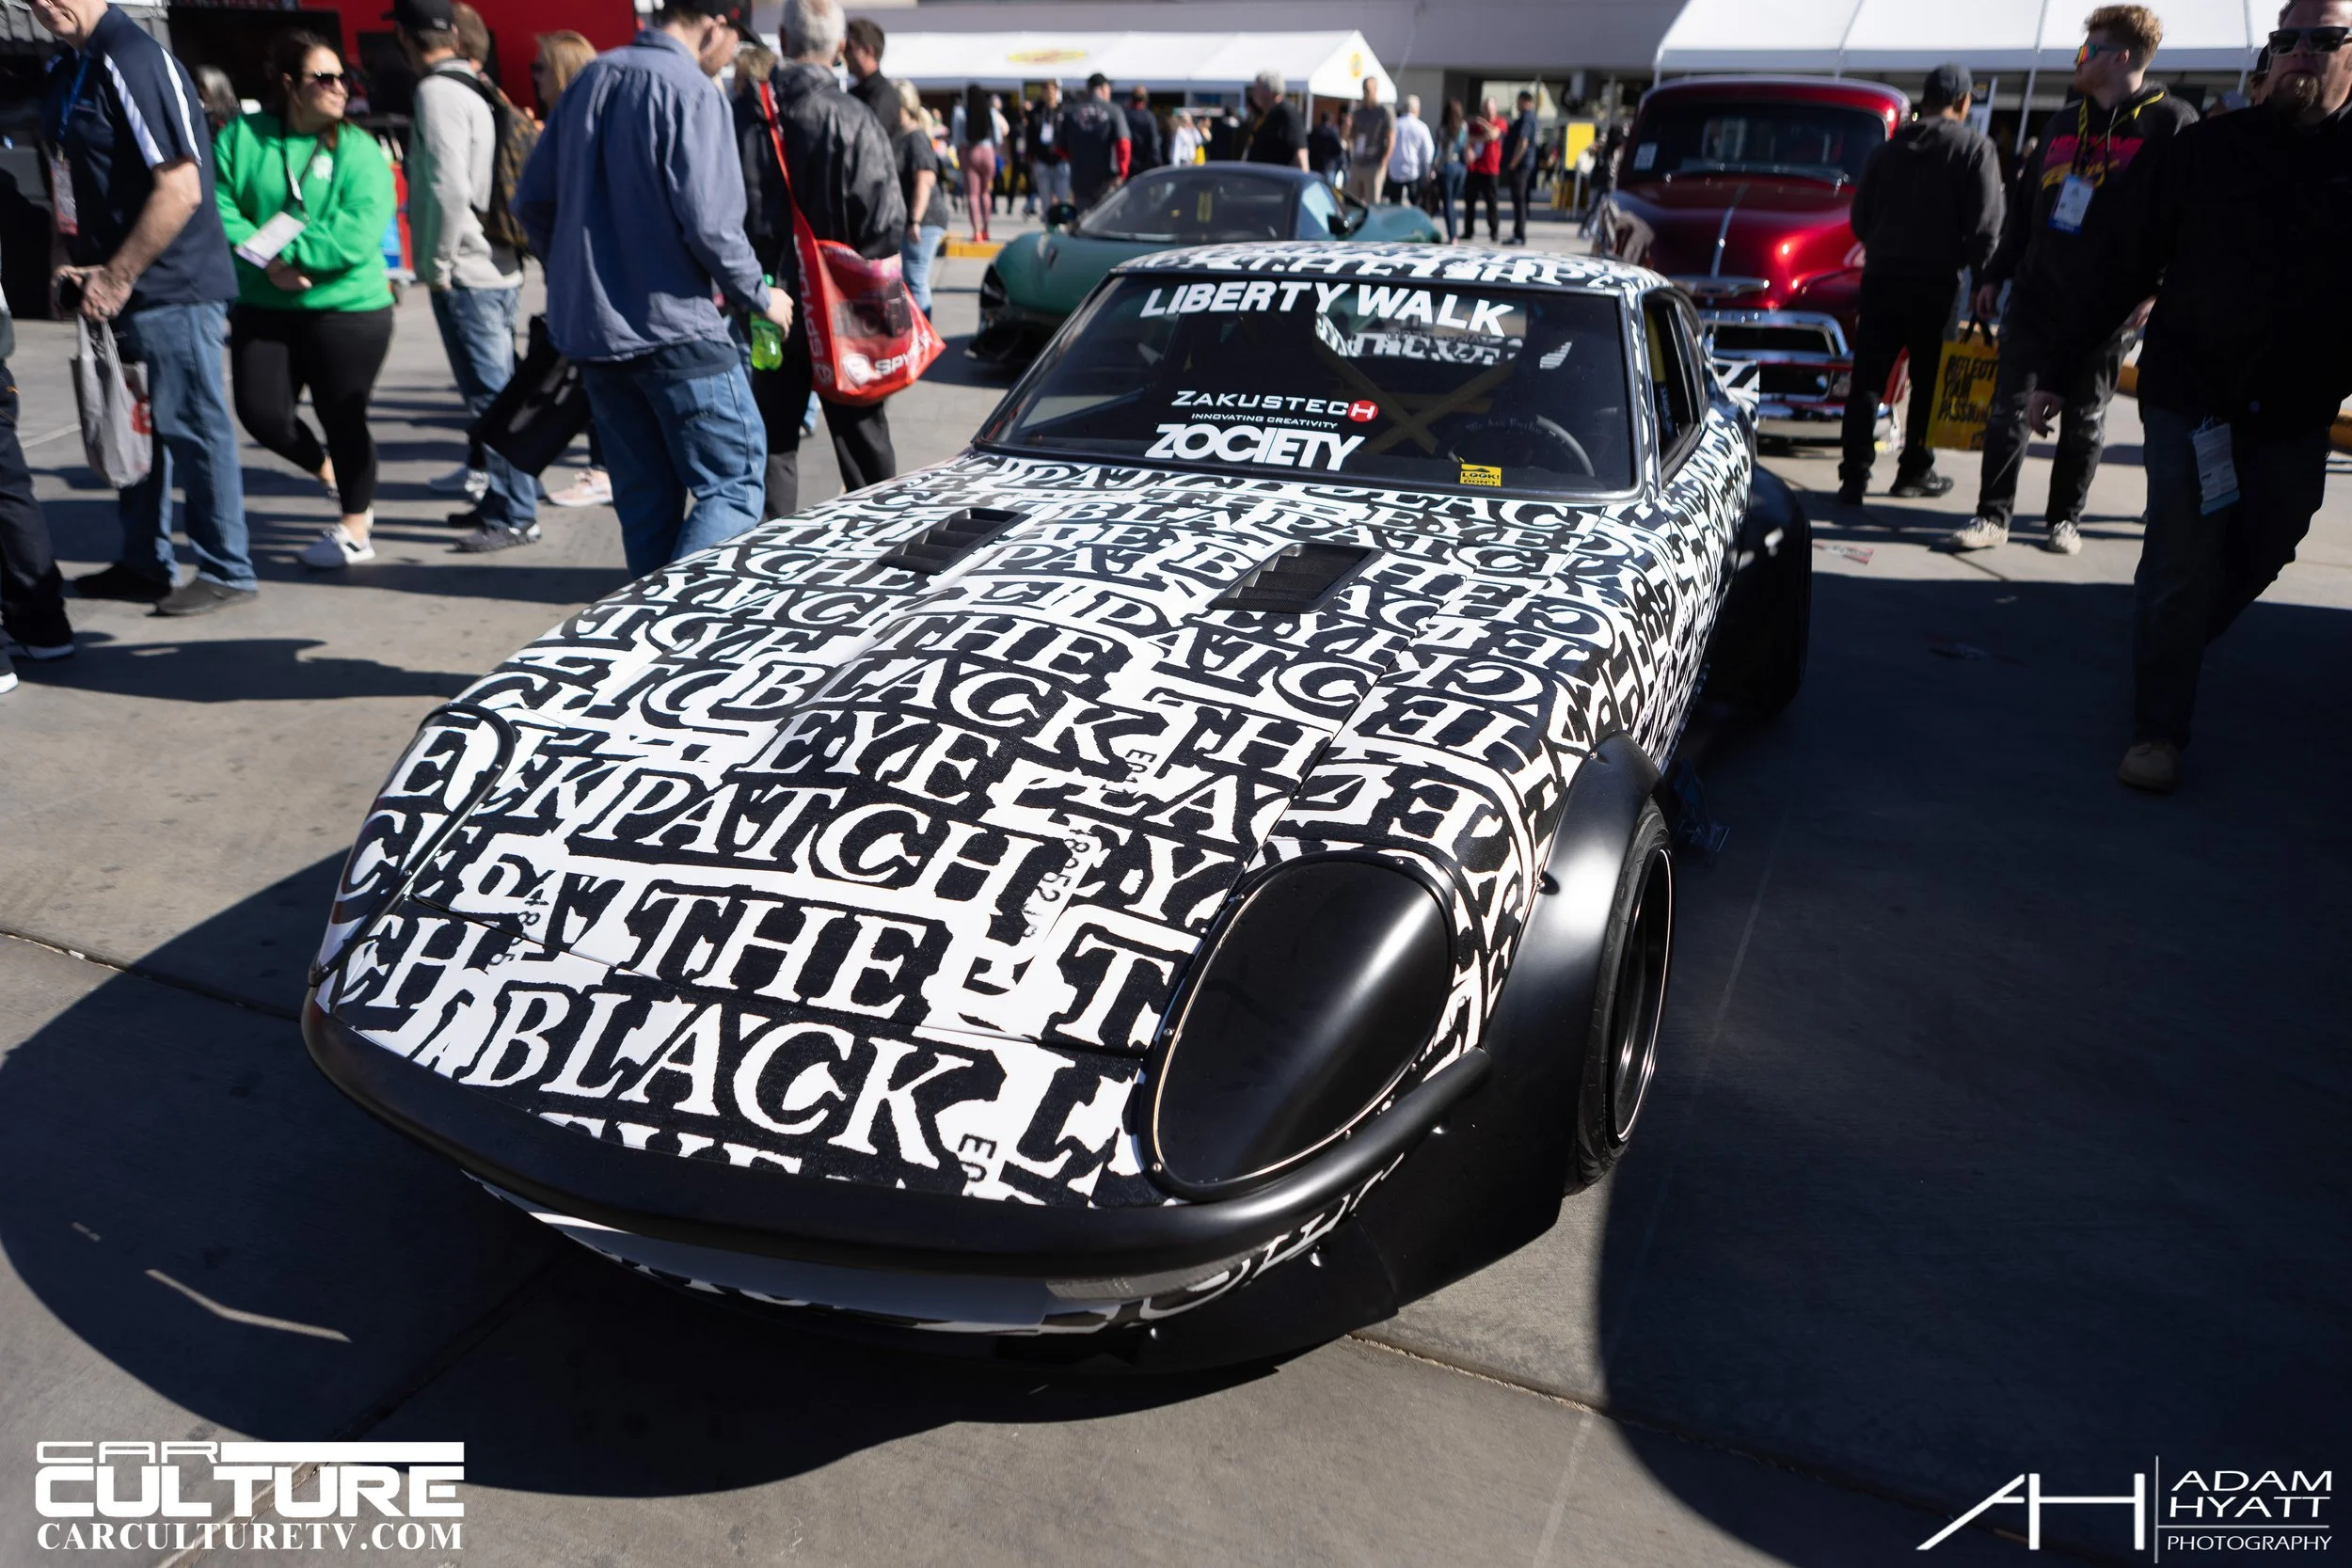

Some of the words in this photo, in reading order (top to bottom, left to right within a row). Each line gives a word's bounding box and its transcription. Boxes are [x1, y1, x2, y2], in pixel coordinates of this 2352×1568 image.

[1139, 281, 1351, 318] LIBERTY
[1356, 284, 1515, 338] WALK
[1144, 423, 1365, 470] ZOCIETY
[1171, 390, 1377, 420] ZAKUSTECH
[1191, 412, 1263, 422] INNOVATING
[1267, 415, 1338, 429] CREATIVITY
[724, 658, 1144, 765] BLACK
[738, 708, 1001, 804] EYE
[580, 769, 1046, 916] PATCH
[613, 886, 929, 1020] THE
[459, 990, 941, 1169] BLACK
